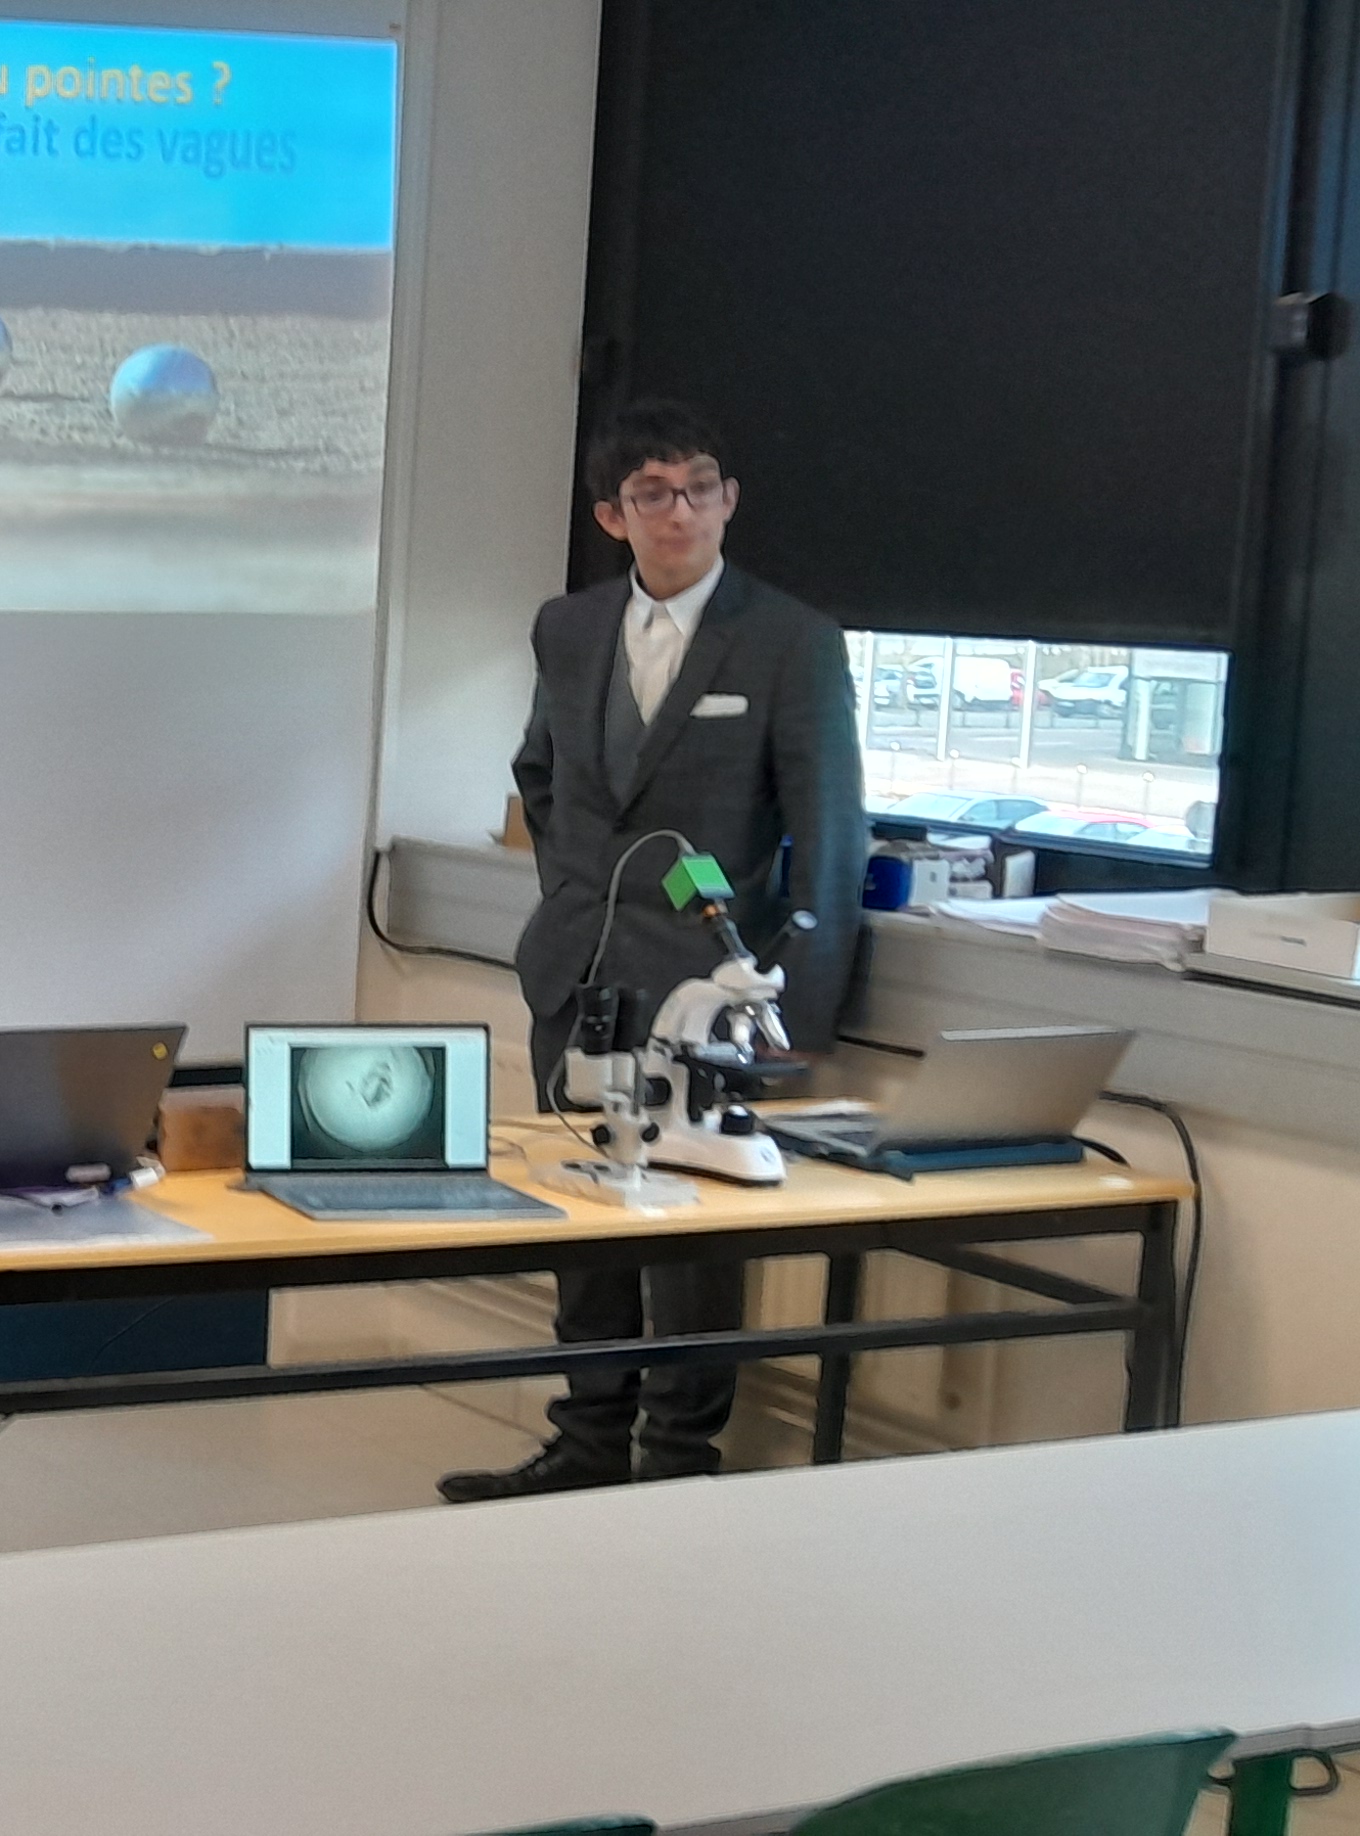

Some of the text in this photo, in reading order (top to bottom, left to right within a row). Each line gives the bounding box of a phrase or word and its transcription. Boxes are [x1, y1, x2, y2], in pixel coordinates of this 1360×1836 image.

[24, 55, 195, 108] pointes
[210, 60, 233, 106] ?
[74, 114, 145, 162] des
[156, 128, 297, 179] vagues
